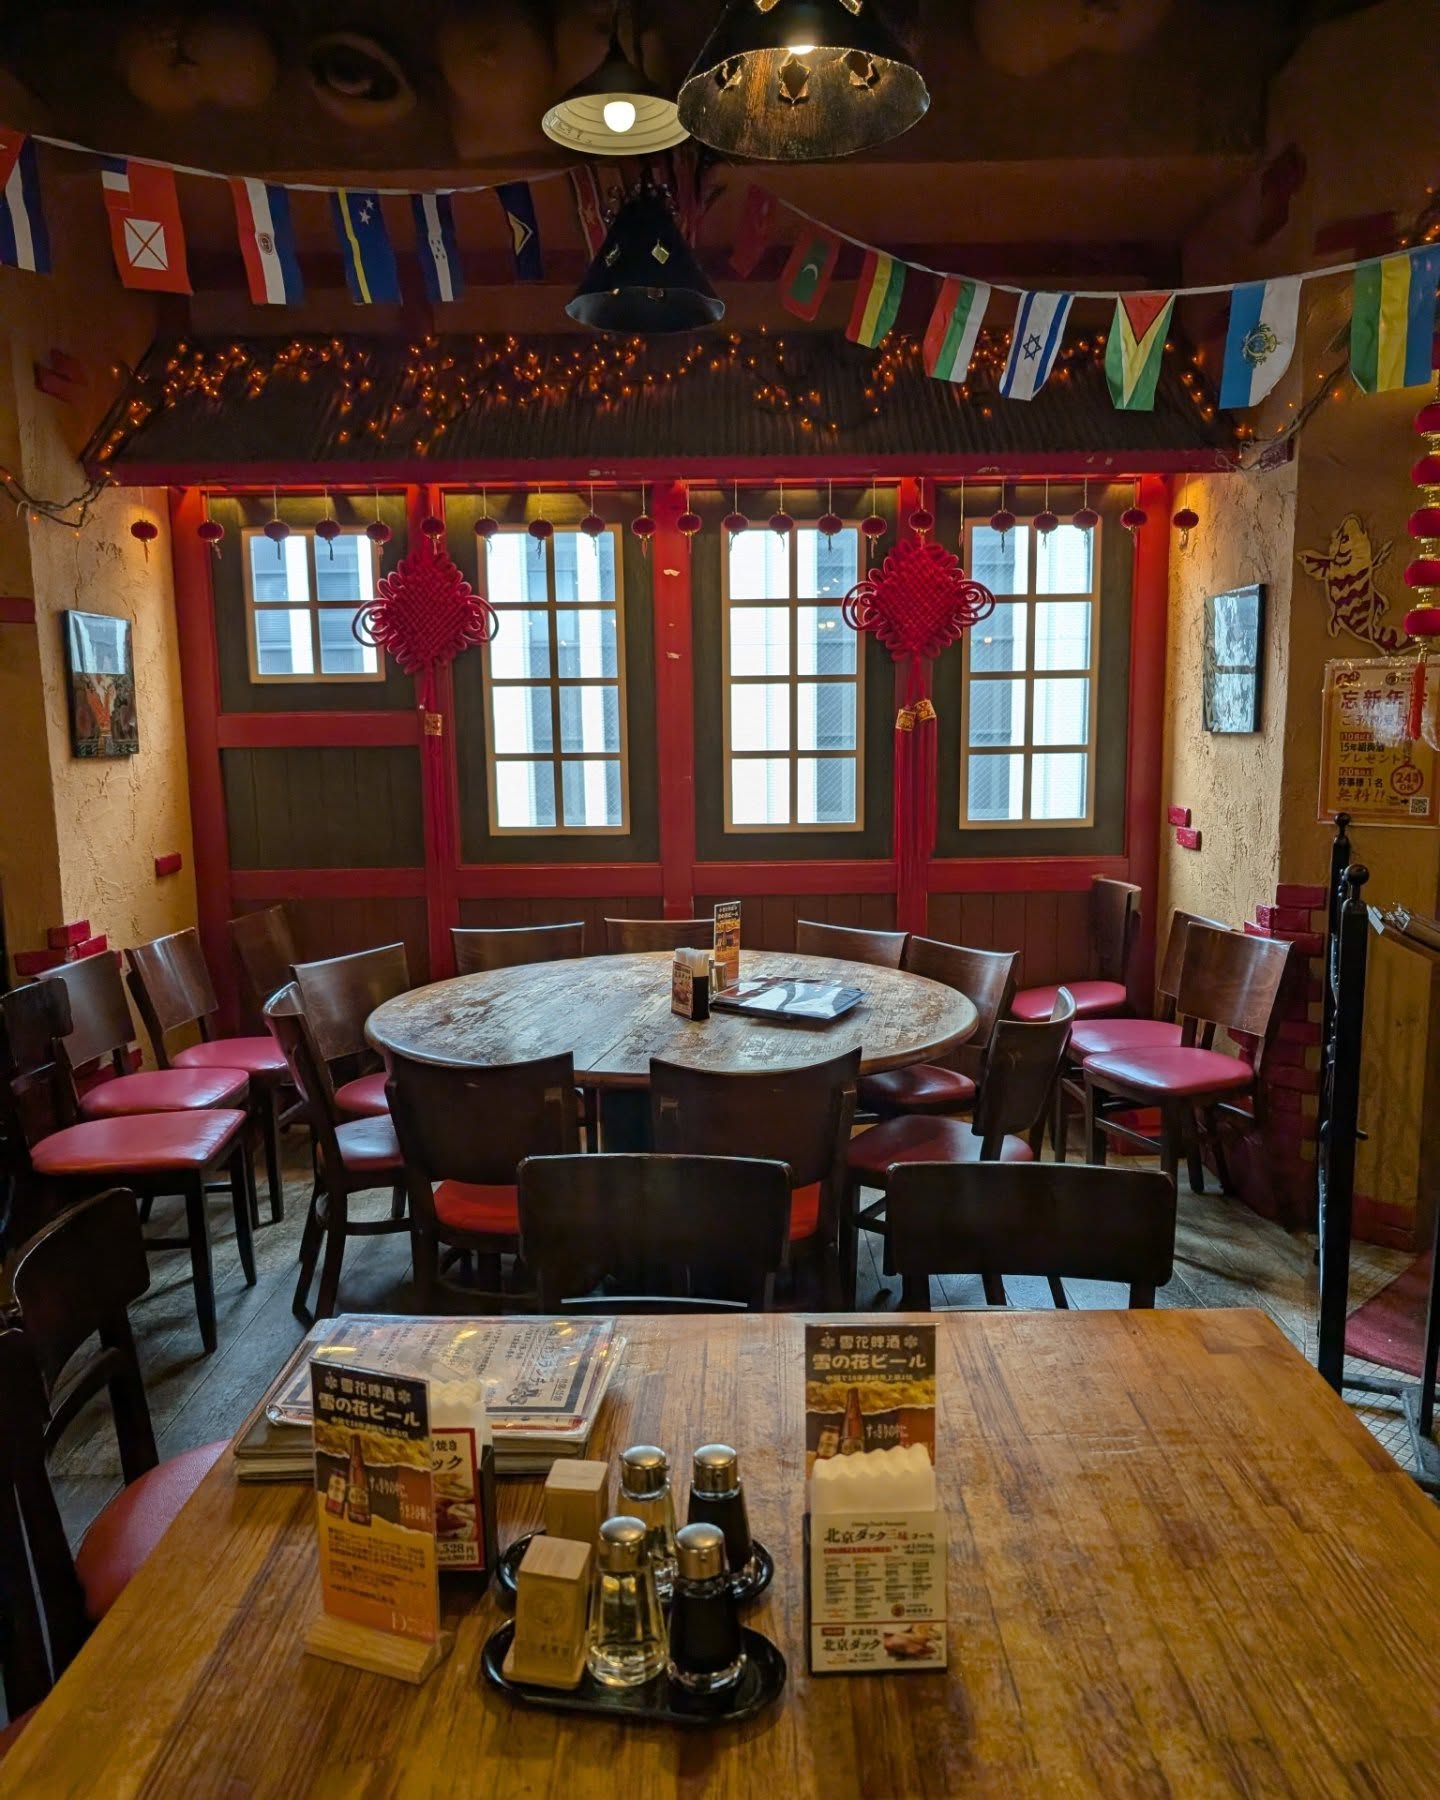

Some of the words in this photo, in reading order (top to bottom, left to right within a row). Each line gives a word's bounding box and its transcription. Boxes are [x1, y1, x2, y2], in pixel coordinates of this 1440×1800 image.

[1341, 689, 1428, 710] 忘新年
[1340, 753, 1401, 764] プレゼント
[840, 1335, 900, 1349] 雪花啤酒
[812, 1353, 927, 1370] 雪の花ビール
[340, 1377, 396, 1402] 雪花啤酒
[318, 1393, 421, 1427] 雪の花ビール
[431, 1439, 457, 1451] 焼き
[431, 1455, 463, 1471] ック
[822, 1637, 881, 1650] 北京ダック
